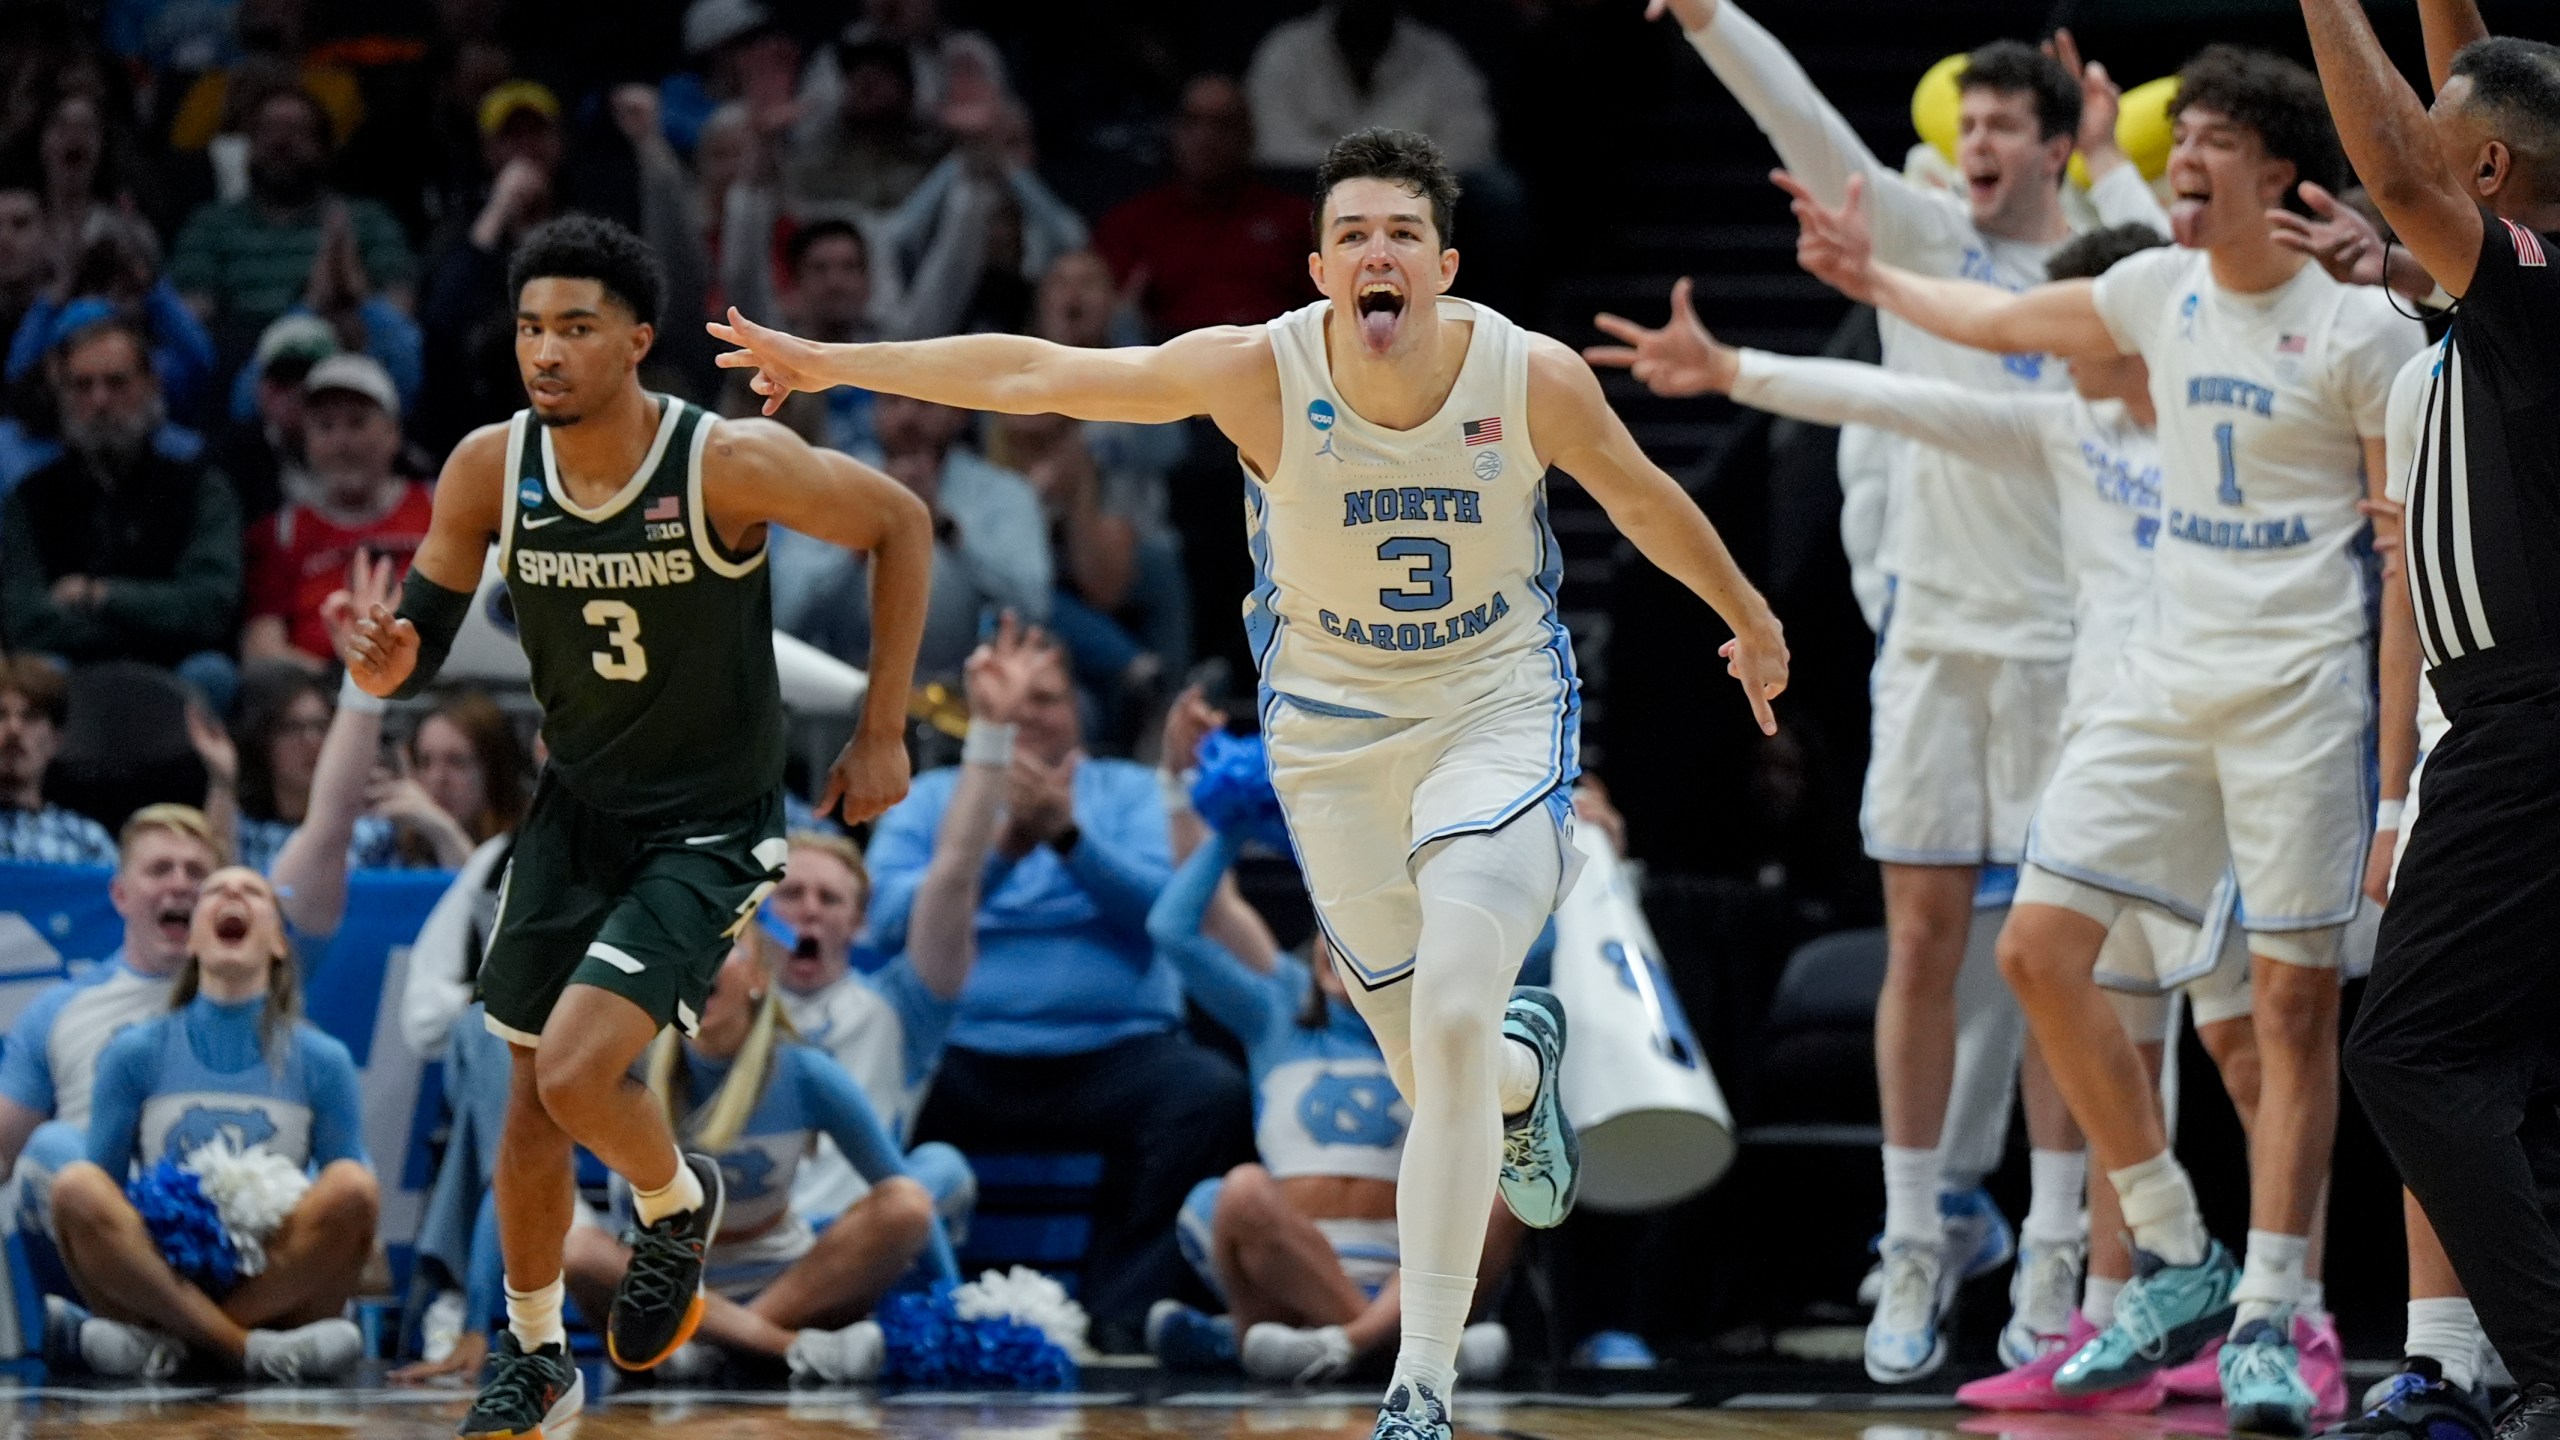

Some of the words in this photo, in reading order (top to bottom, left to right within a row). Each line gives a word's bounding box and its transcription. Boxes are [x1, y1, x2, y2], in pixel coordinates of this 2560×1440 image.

[2214, 422, 2243, 506] 1
[1343, 487, 1482, 527] NORTH
[2168, 509, 2310, 549] CAROLINA
[516, 549, 695, 588] SPARTANS
[1377, 536, 1453, 612] 3
[582, 600, 648, 682] 3
[1319, 591, 1510, 651] CAROLINA
